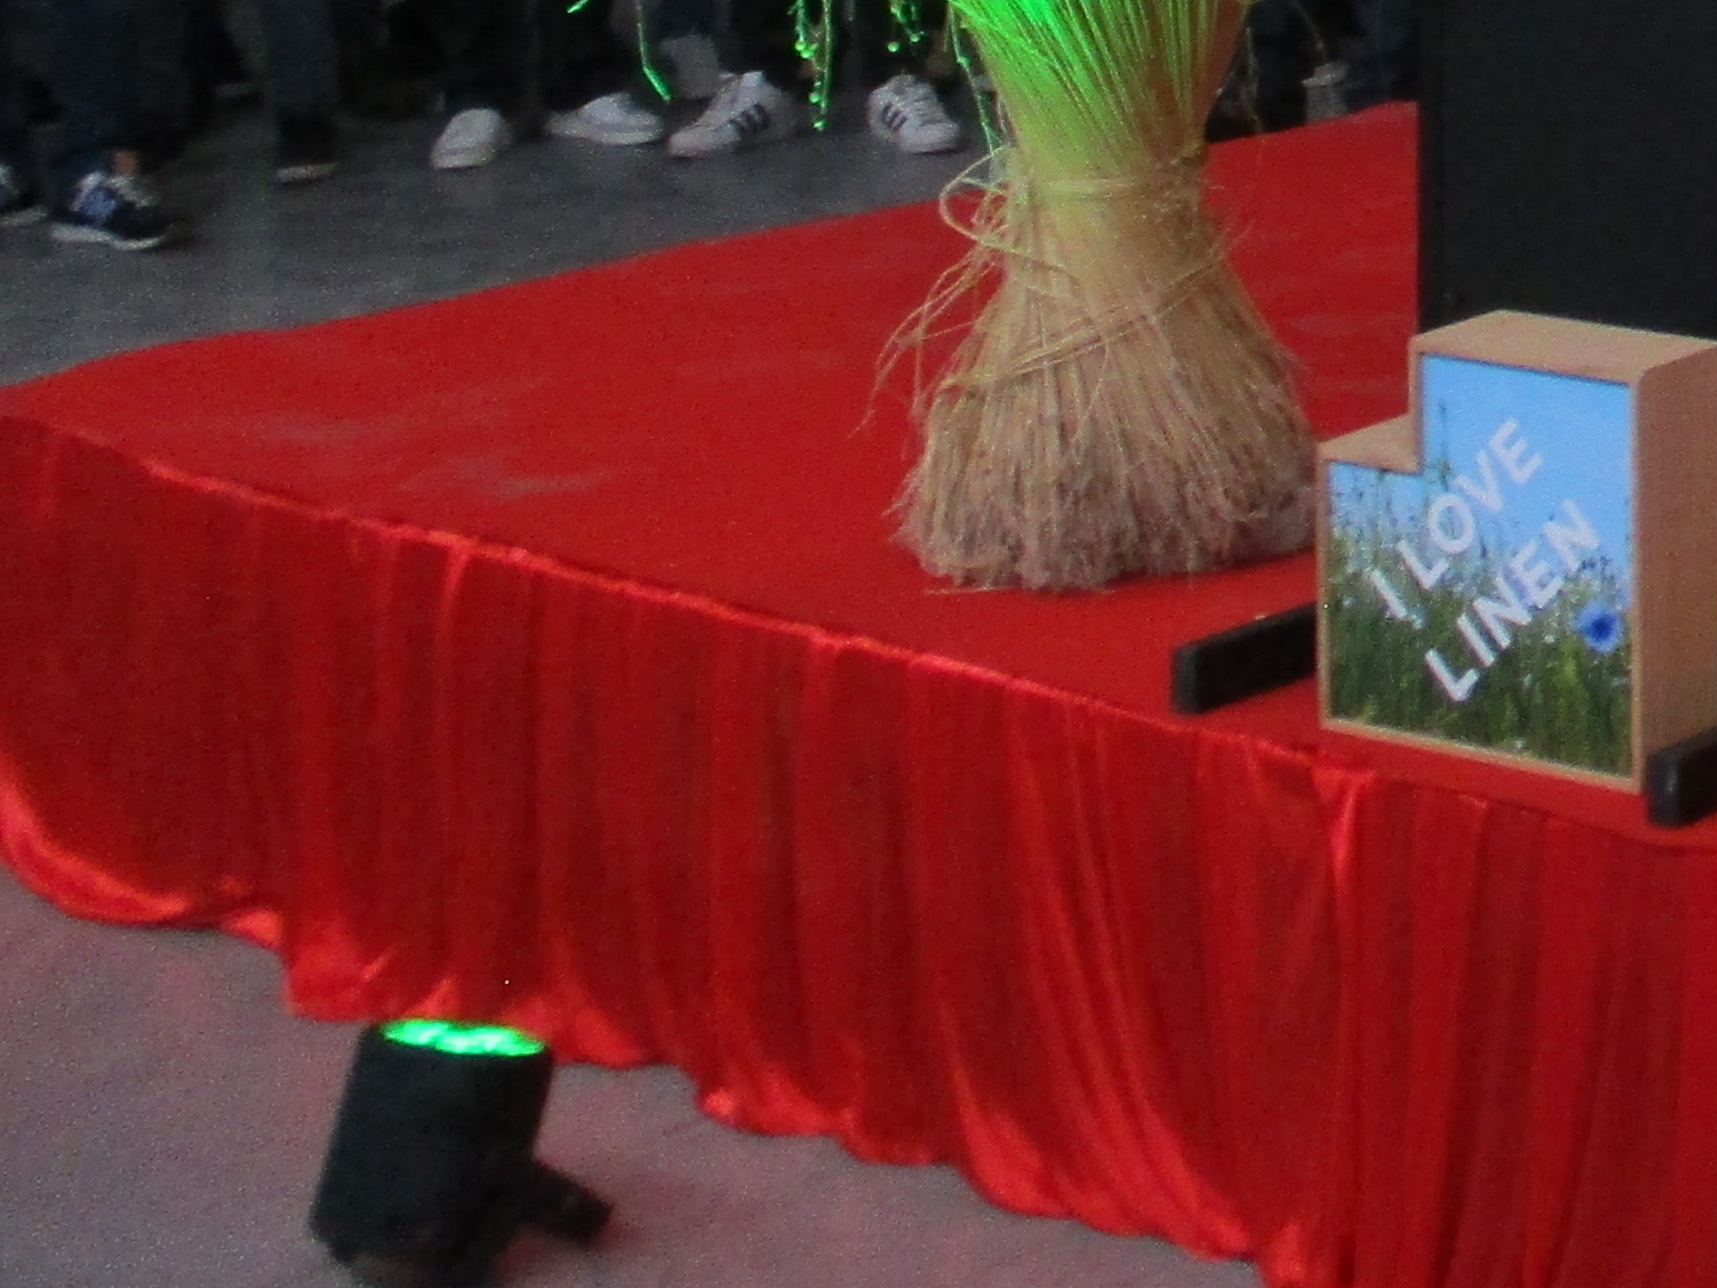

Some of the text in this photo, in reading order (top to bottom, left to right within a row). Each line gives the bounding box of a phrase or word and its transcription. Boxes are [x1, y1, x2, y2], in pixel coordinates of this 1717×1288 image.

[1365, 417, 1544, 620] I LOVE
[1424, 499, 1600, 703] LINEN
